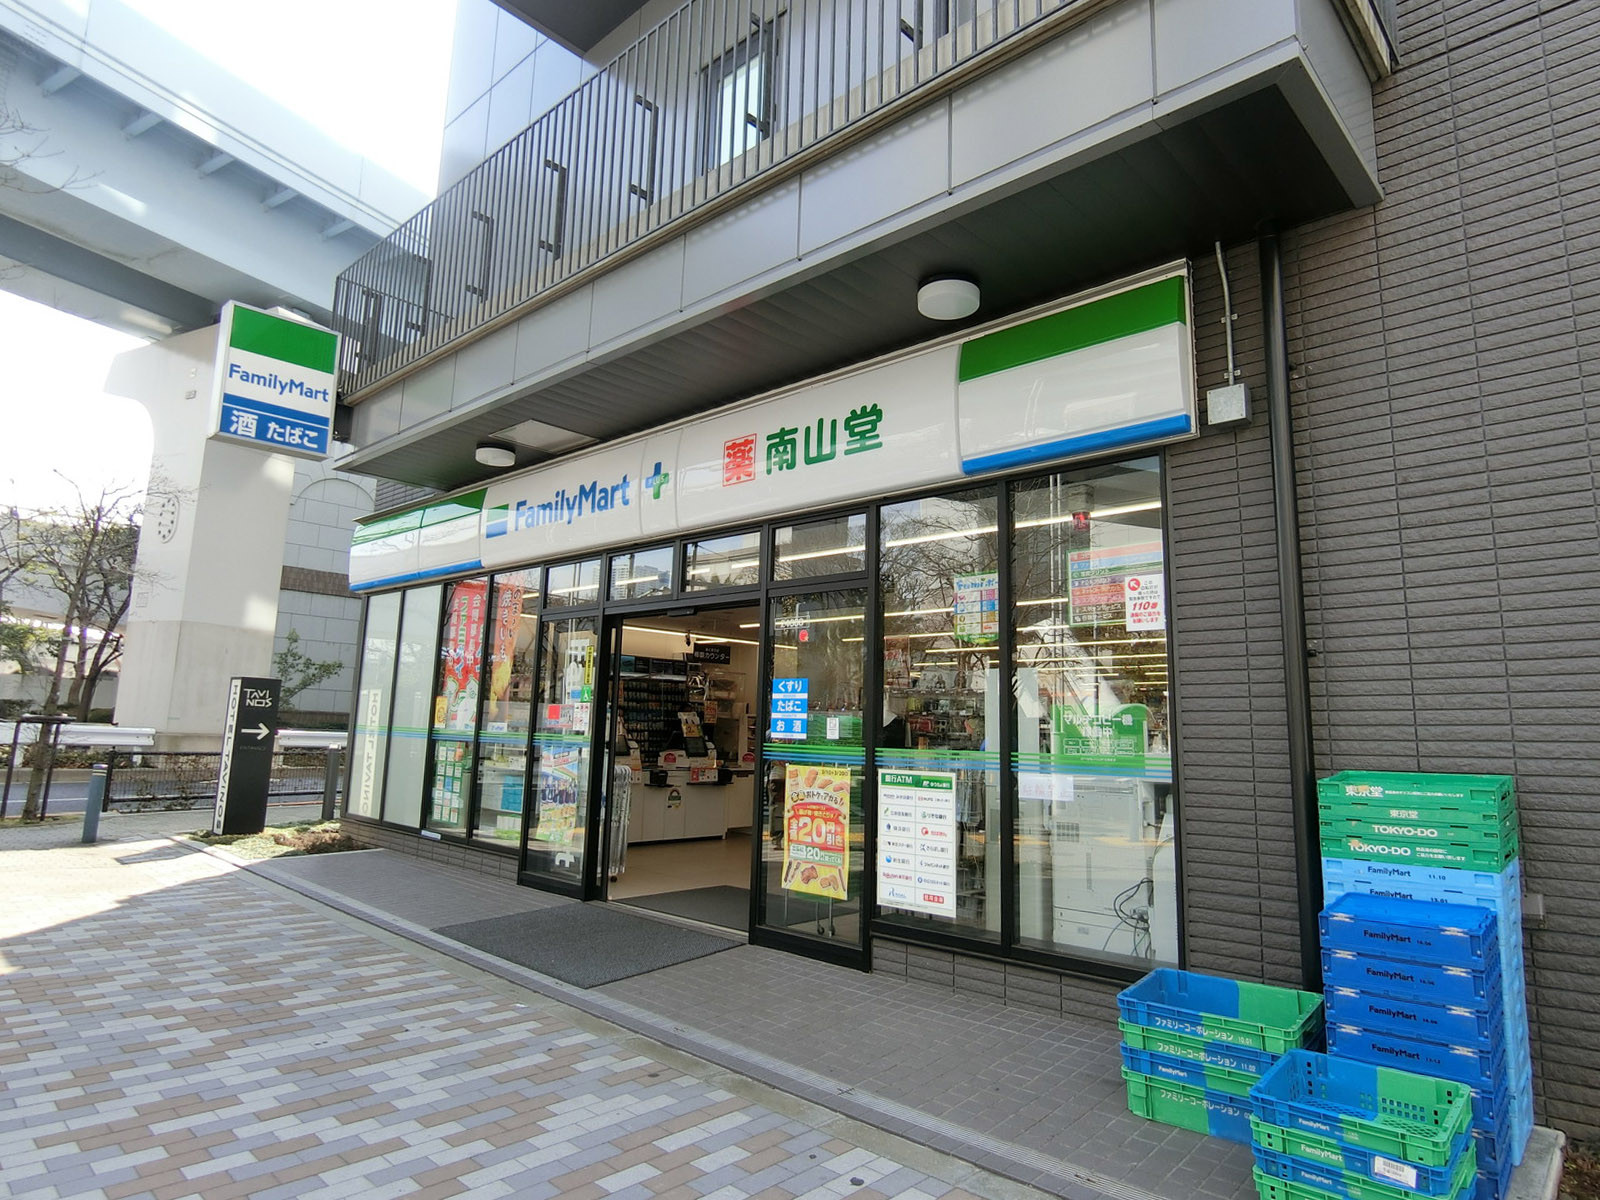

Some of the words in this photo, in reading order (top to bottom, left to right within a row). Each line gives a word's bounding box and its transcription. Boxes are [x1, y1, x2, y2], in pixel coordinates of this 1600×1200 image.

[228, 363, 329, 402] FamilyMart
[229, 410, 259, 438] 酒
[267, 421, 319, 448] たばこ
[725, 438, 754, 482] 薬
[766, 403, 883, 475] 南山堂
[515, 474, 630, 532] FamilyMart
[778, 680, 802, 692] くすり
[777, 700, 802, 712] たばこ
[223, 684, 239, 747] HOTEL
[885, 774, 913, 784] 銀行ATM
[216, 752, 230, 829] TAVINOS
[1345, 785, 1384, 798] 東京堂
[1390, 810, 1419, 819] 東京堂
[1372, 824, 1438, 837] TOKYO-DO
[1348, 842, 1411, 856] TOKYO-DO
[1367, 866, 1412, 877] FamilyMart
[1370, 888, 1413, 900] FamilyMart
[1363, 929, 1412, 944] FamilyMart
[1366, 967, 1415, 982] FamilyMart
[1369, 1004, 1417, 1020] FamilyMart
[1154, 1017, 1234, 1041] ファミリーコーポレーション
[1157, 1043, 1237, 1067] ファミリーコーポレーション
[1241, 1063, 1257, 1072] 11.02
[1371, 1043, 1420, 1060] FamilyMart
[1158, 1065, 1187, 1078] FamilyMart
[1160, 1089, 1240, 1116] ファミリーコーポレーション
[1298, 1117, 1330, 1132] FamilyMart
[1300, 1144, 1343, 1162] FamilyMart
[1301, 1170, 1333, 1186] FamilyMart
